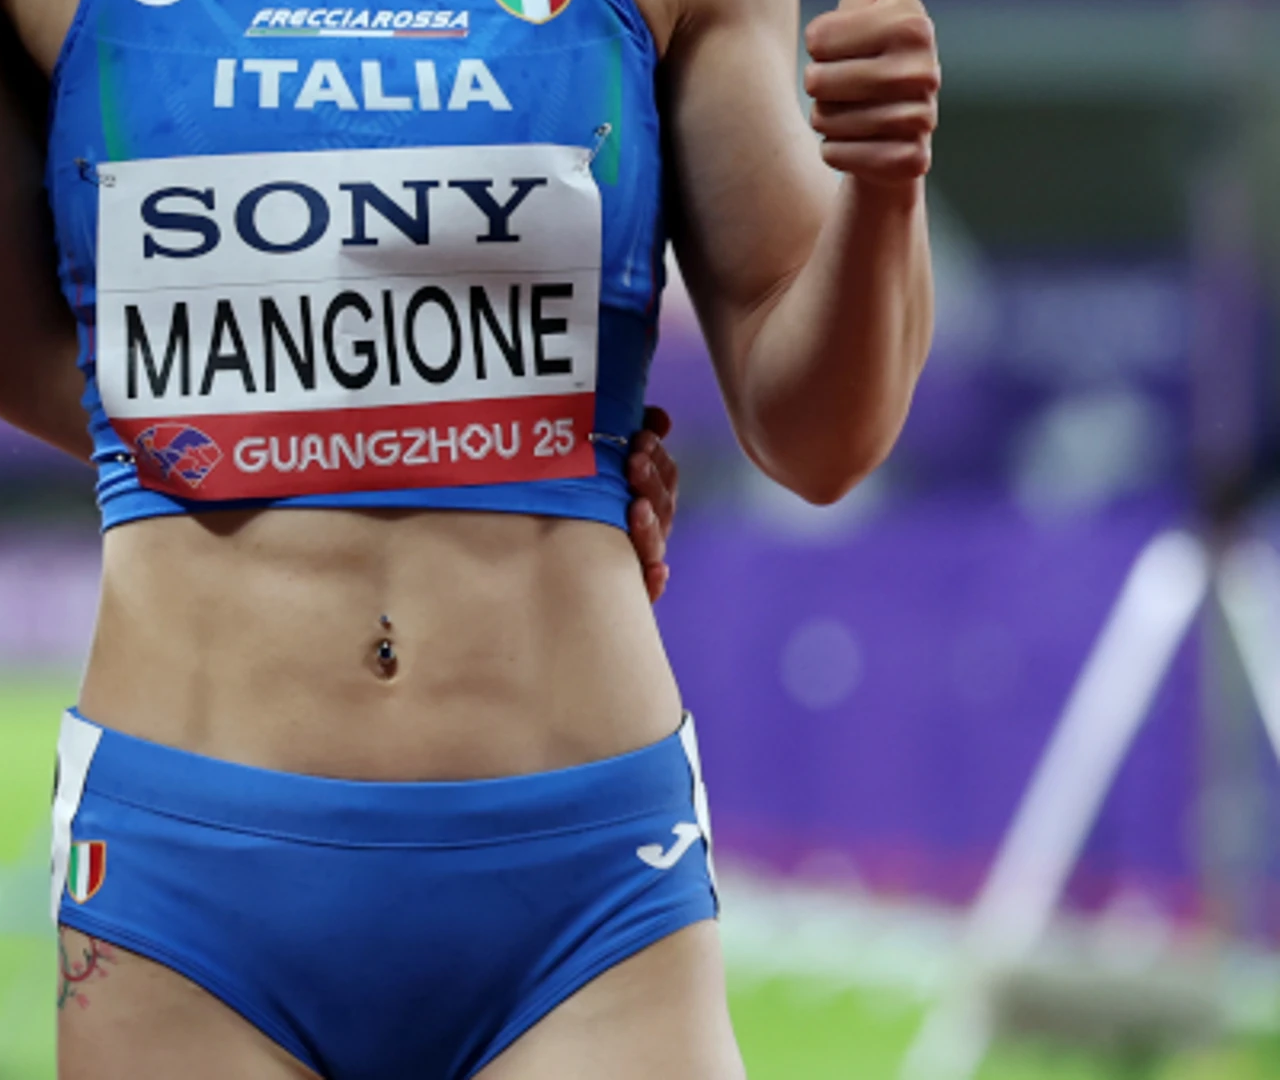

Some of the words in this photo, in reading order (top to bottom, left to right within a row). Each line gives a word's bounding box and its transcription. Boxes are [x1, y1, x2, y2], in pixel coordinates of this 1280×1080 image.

[251, 6, 470, 30] FRECCIAROSSA
[212, 58, 513, 112] ITALIA
[140, 176, 548, 259] SONY
[124, 281, 574, 400] MANGIONE
[232, 421, 521, 474] GUANGZHOU
[532, 417, 575, 457] 25
